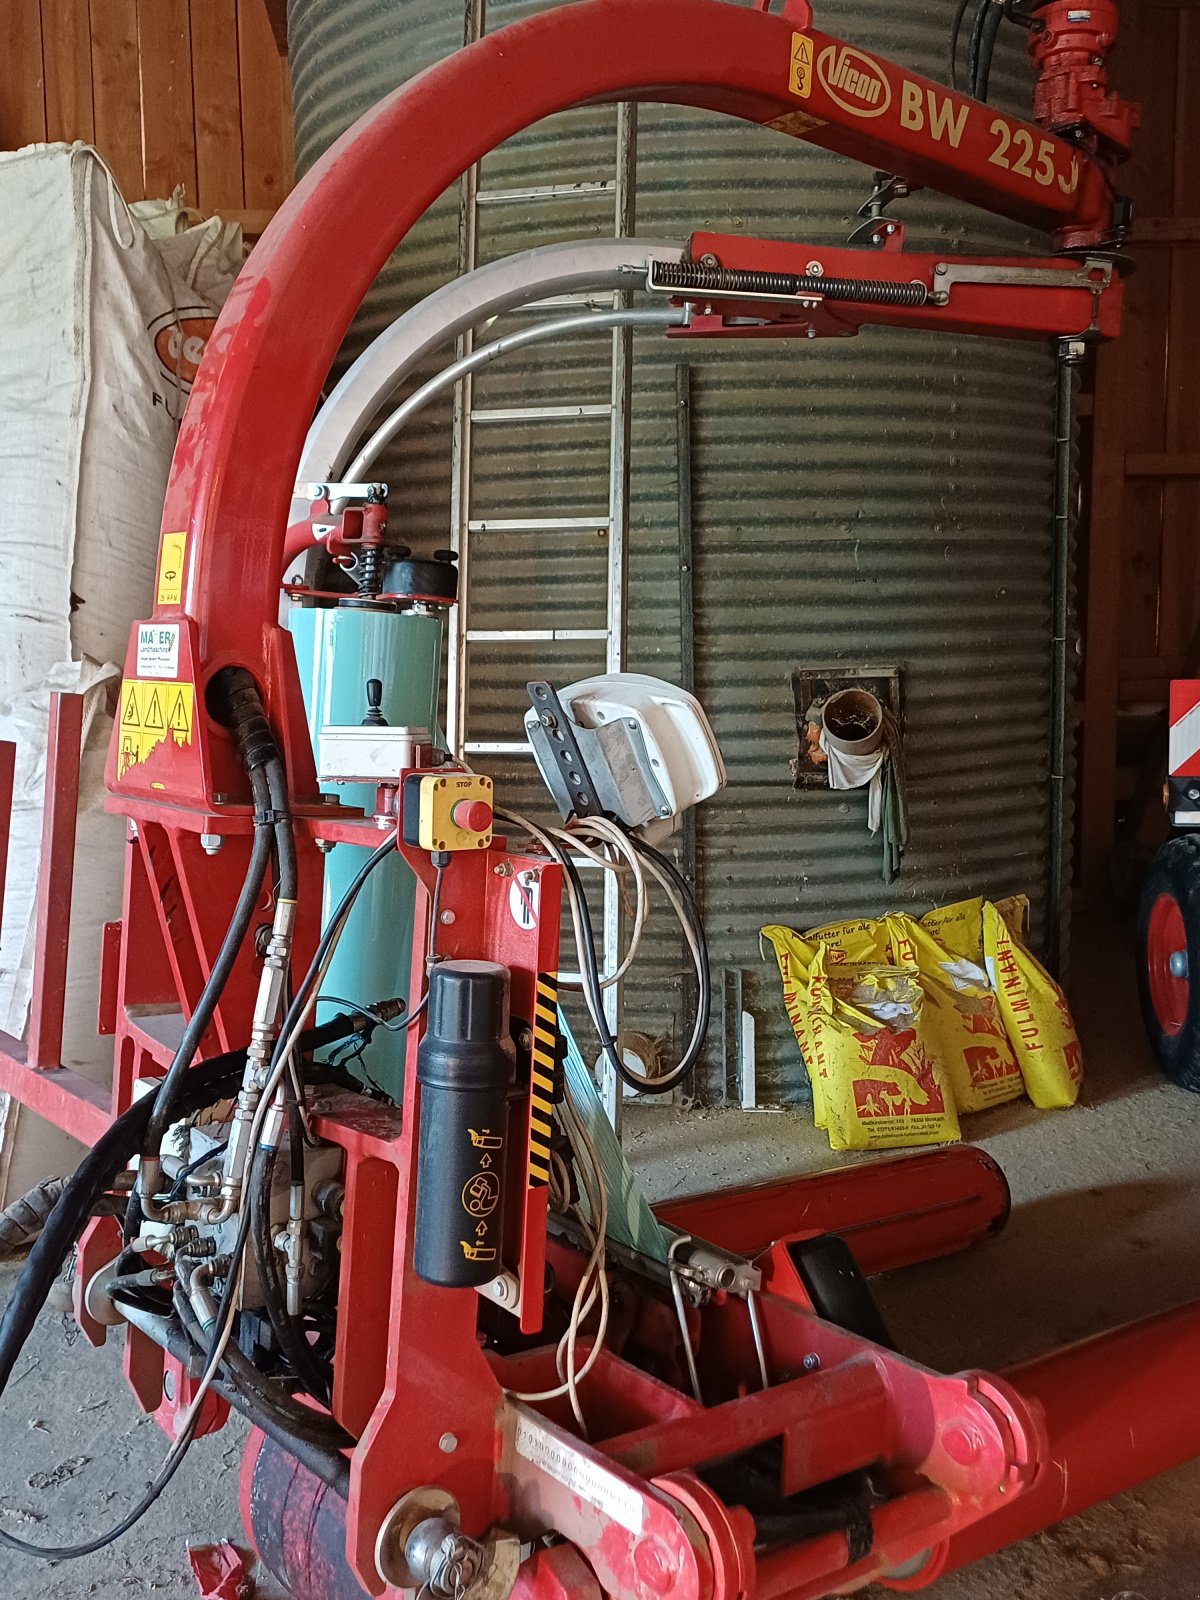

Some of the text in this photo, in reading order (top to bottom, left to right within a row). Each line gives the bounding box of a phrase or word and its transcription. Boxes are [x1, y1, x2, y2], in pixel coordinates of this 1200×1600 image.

[828, 46, 882, 104] Vicon
[900, 79, 970, 149] BW
[140, 629, 172, 645] MAER
[997, 939, 1044, 1051] FULMINANT
